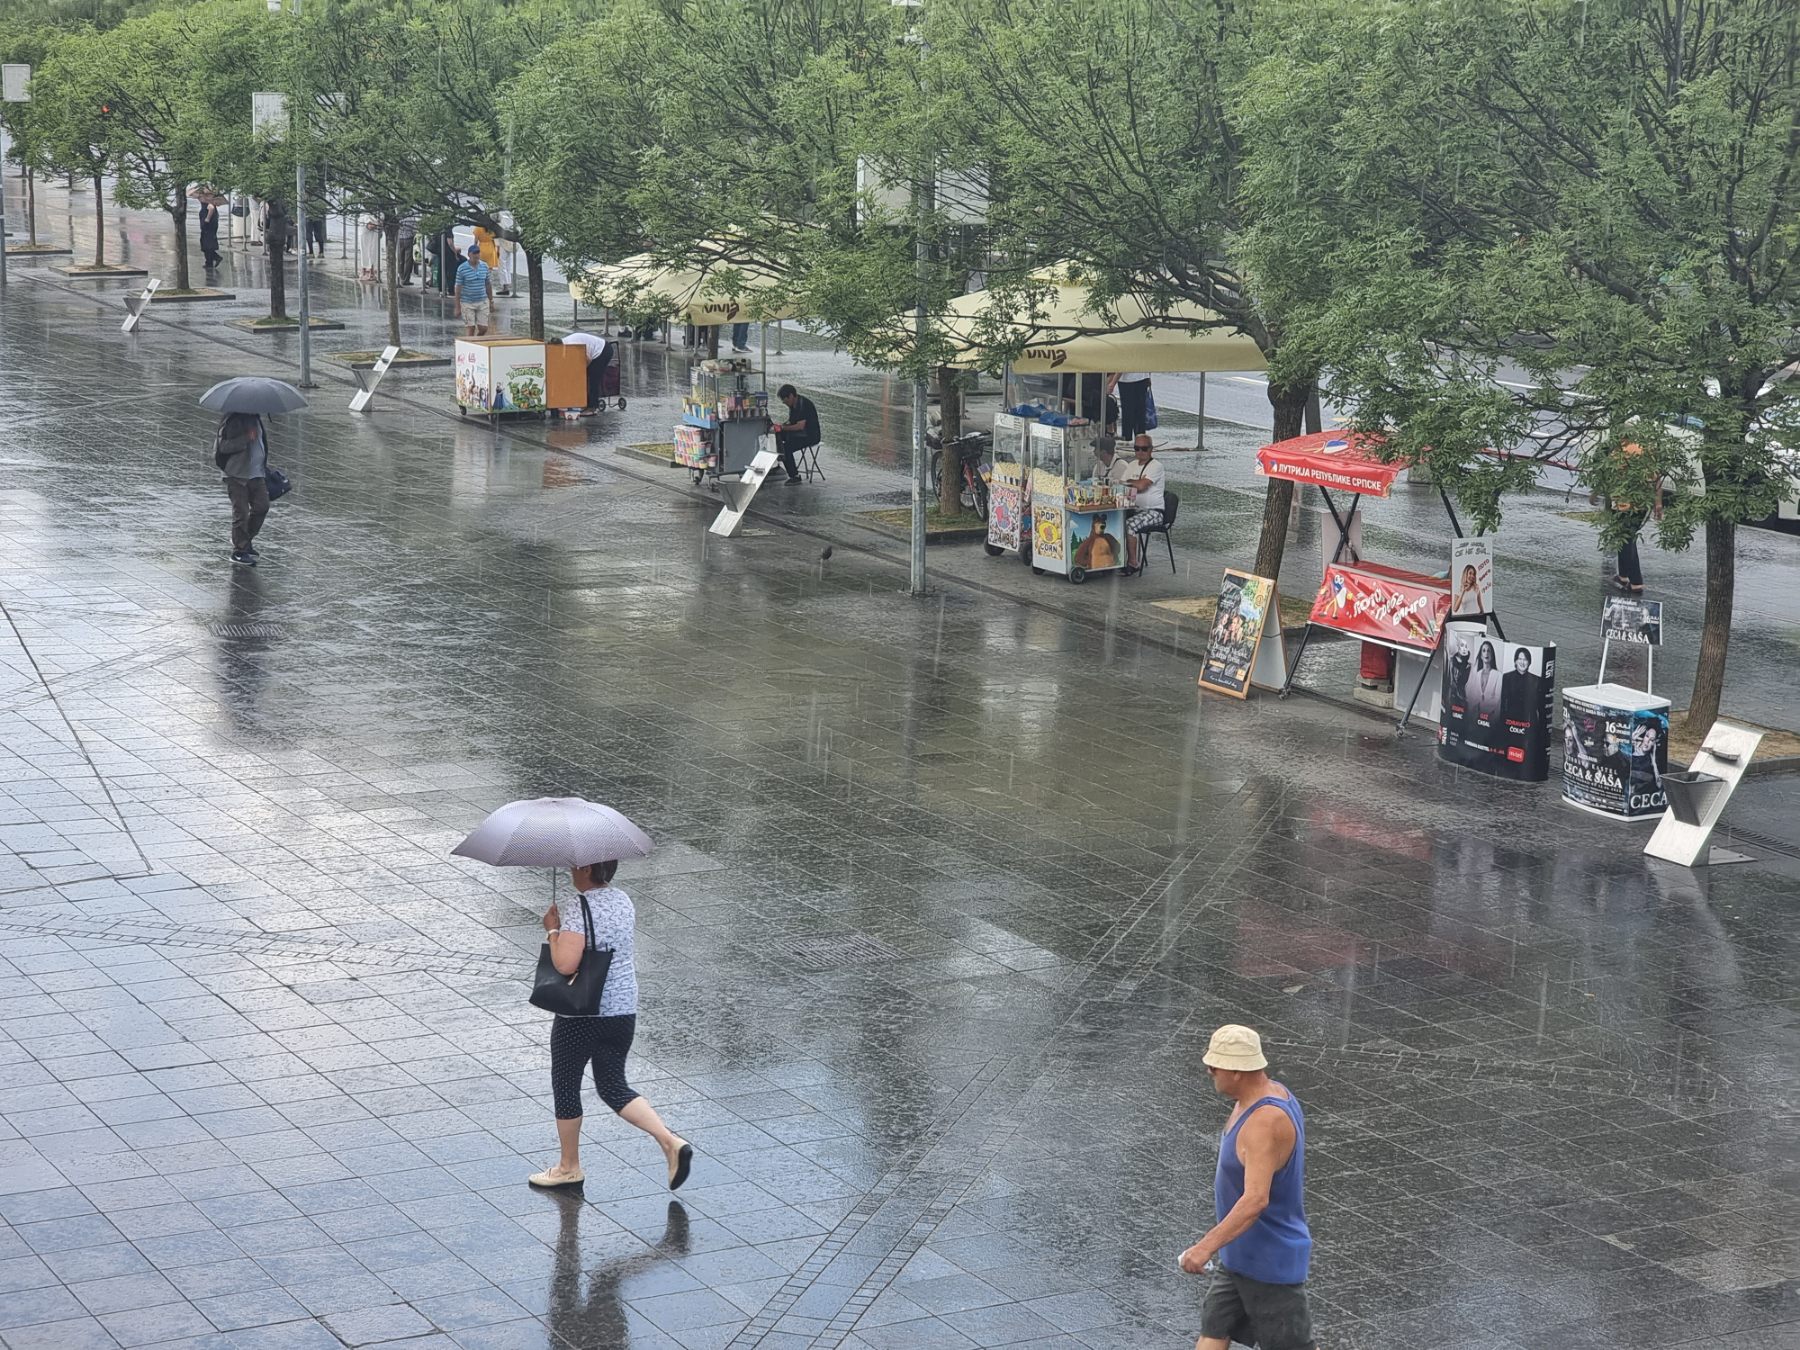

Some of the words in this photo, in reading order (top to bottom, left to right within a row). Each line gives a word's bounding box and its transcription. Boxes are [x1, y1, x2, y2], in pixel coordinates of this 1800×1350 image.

[1278, 463, 1310, 478] ЛУТРИЈА
[1311, 469, 1351, 486] РЕПУБЛИКЕ
[1352, 477, 1382, 491] СРПСКЕ
[1040, 510, 1055, 521] POP
[1040, 542, 1058, 553] CORN
[1605, 721, 1616, 734] 16
[1563, 760, 1584, 779] CECA
[1584, 769, 1593, 782] &
[1630, 791, 1669, 809] CECA
